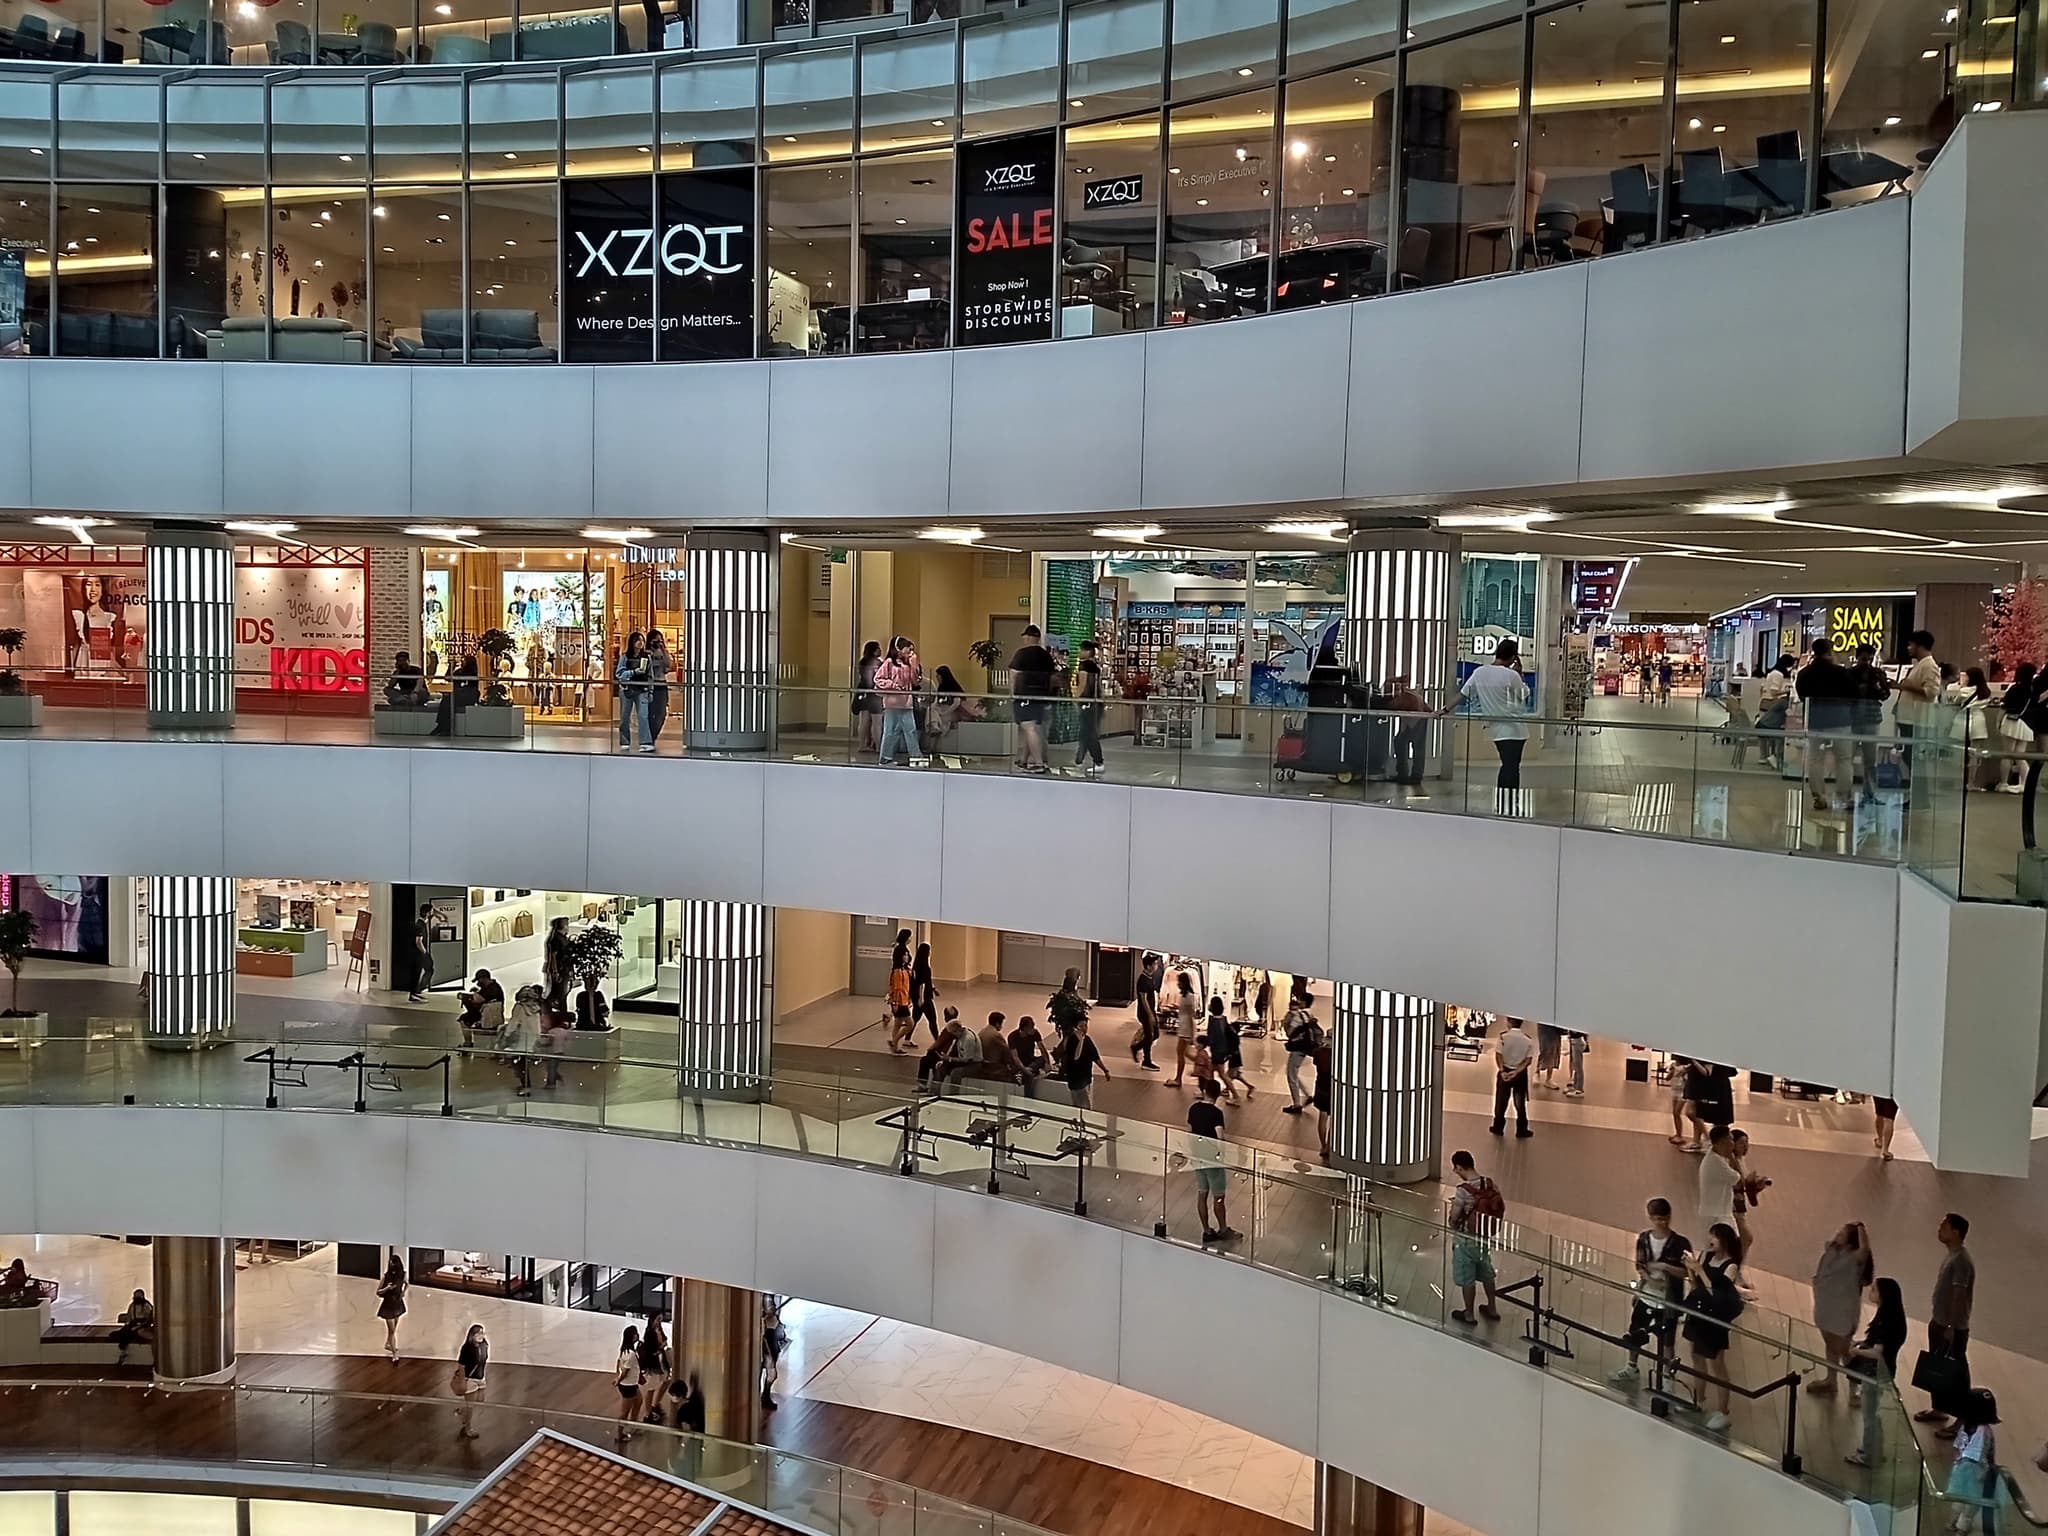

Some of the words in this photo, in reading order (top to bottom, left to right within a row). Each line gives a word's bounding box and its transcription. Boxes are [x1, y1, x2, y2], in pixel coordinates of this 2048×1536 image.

[984, 163, 1037, 186] XZQT
[1190, 172, 1217, 185] Simply
[1218, 165, 1257, 181] Executive
[1086, 179, 1142, 204] XZQT
[967, 208, 1053, 253] SALE
[1, 238, 39, 248] Executive
[574, 223, 744, 278] XZQT
[987, 282, 1007, 292] Shop
[1007, 279, 1024, 290] Now
[965, 298, 1052, 317] STOREWIDE
[576, 317, 624, 330] Where
[682, 313, 742, 328] Matters...
[965, 311, 1051, 330] DISCOUNTS
[620, 546, 677, 563] JUNIOR
[118, 578, 146, 589] BELIEVE
[287, 598, 314, 619] You
[298, 602, 329, 627] will
[1604, 624, 1658, 634] PARKSON
[1832, 607, 1884, 631] SIAM
[235, 618, 274, 644] IDS
[434, 632, 477, 641] MALAYSIA
[1831, 631, 1882, 652] OASIS
[270, 647, 365, 692] KIDS
